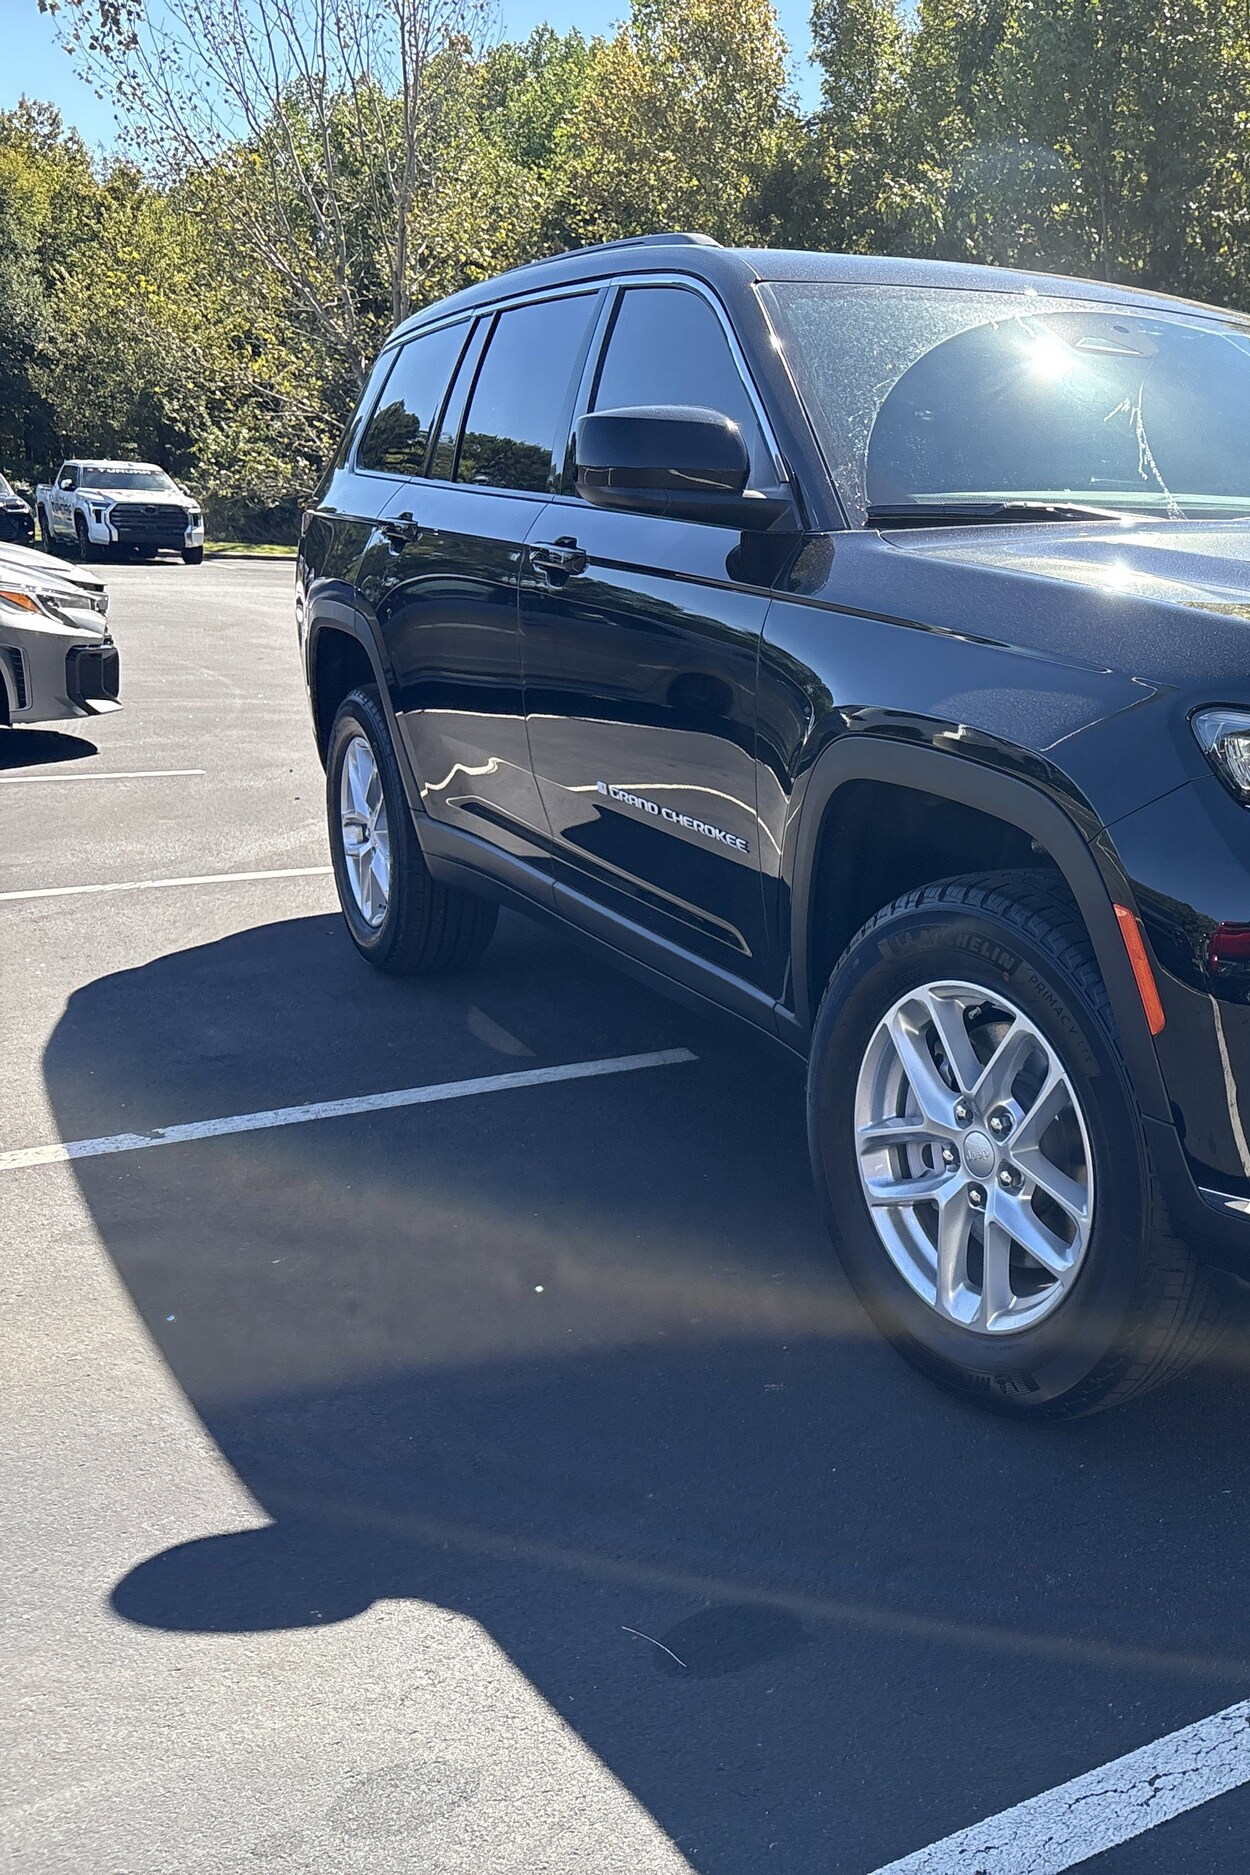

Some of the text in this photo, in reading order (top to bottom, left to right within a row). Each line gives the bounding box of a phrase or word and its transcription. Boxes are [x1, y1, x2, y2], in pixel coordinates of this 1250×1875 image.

[610, 787, 659, 815] GRAND
[661, 807, 748, 853] CHEROKEE
[920, 929, 1015, 970] MICHELIN
[1029, 974, 1078, 1034] PRIMACY
[966, 1149, 989, 1161] Jeep
